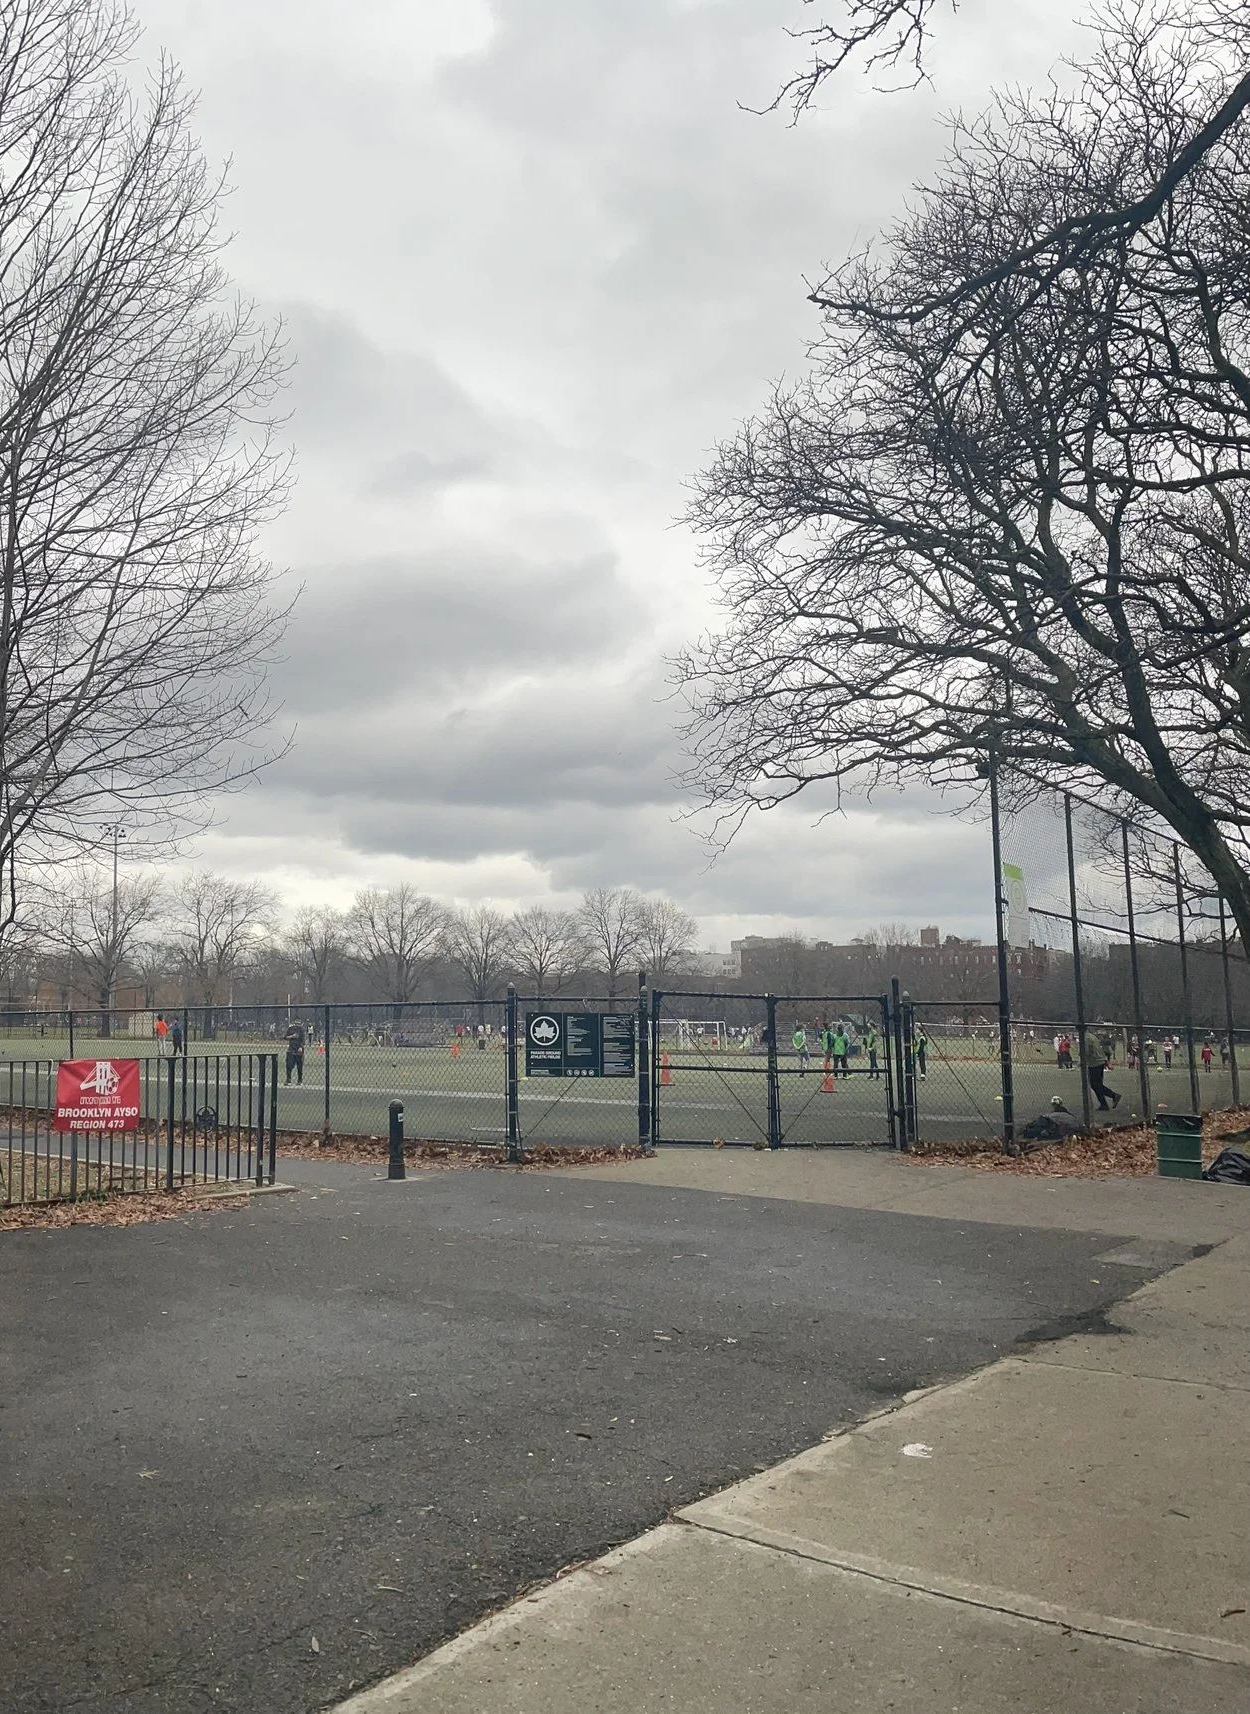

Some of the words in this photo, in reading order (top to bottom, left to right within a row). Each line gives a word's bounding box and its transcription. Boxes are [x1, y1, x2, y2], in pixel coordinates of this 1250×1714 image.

[58, 1108, 111, 1117] BROOKLYN
[114, 1107, 138, 1117] AYSO
[70, 1120, 106, 1129] REGION
[108, 1119, 124, 1128] 473
